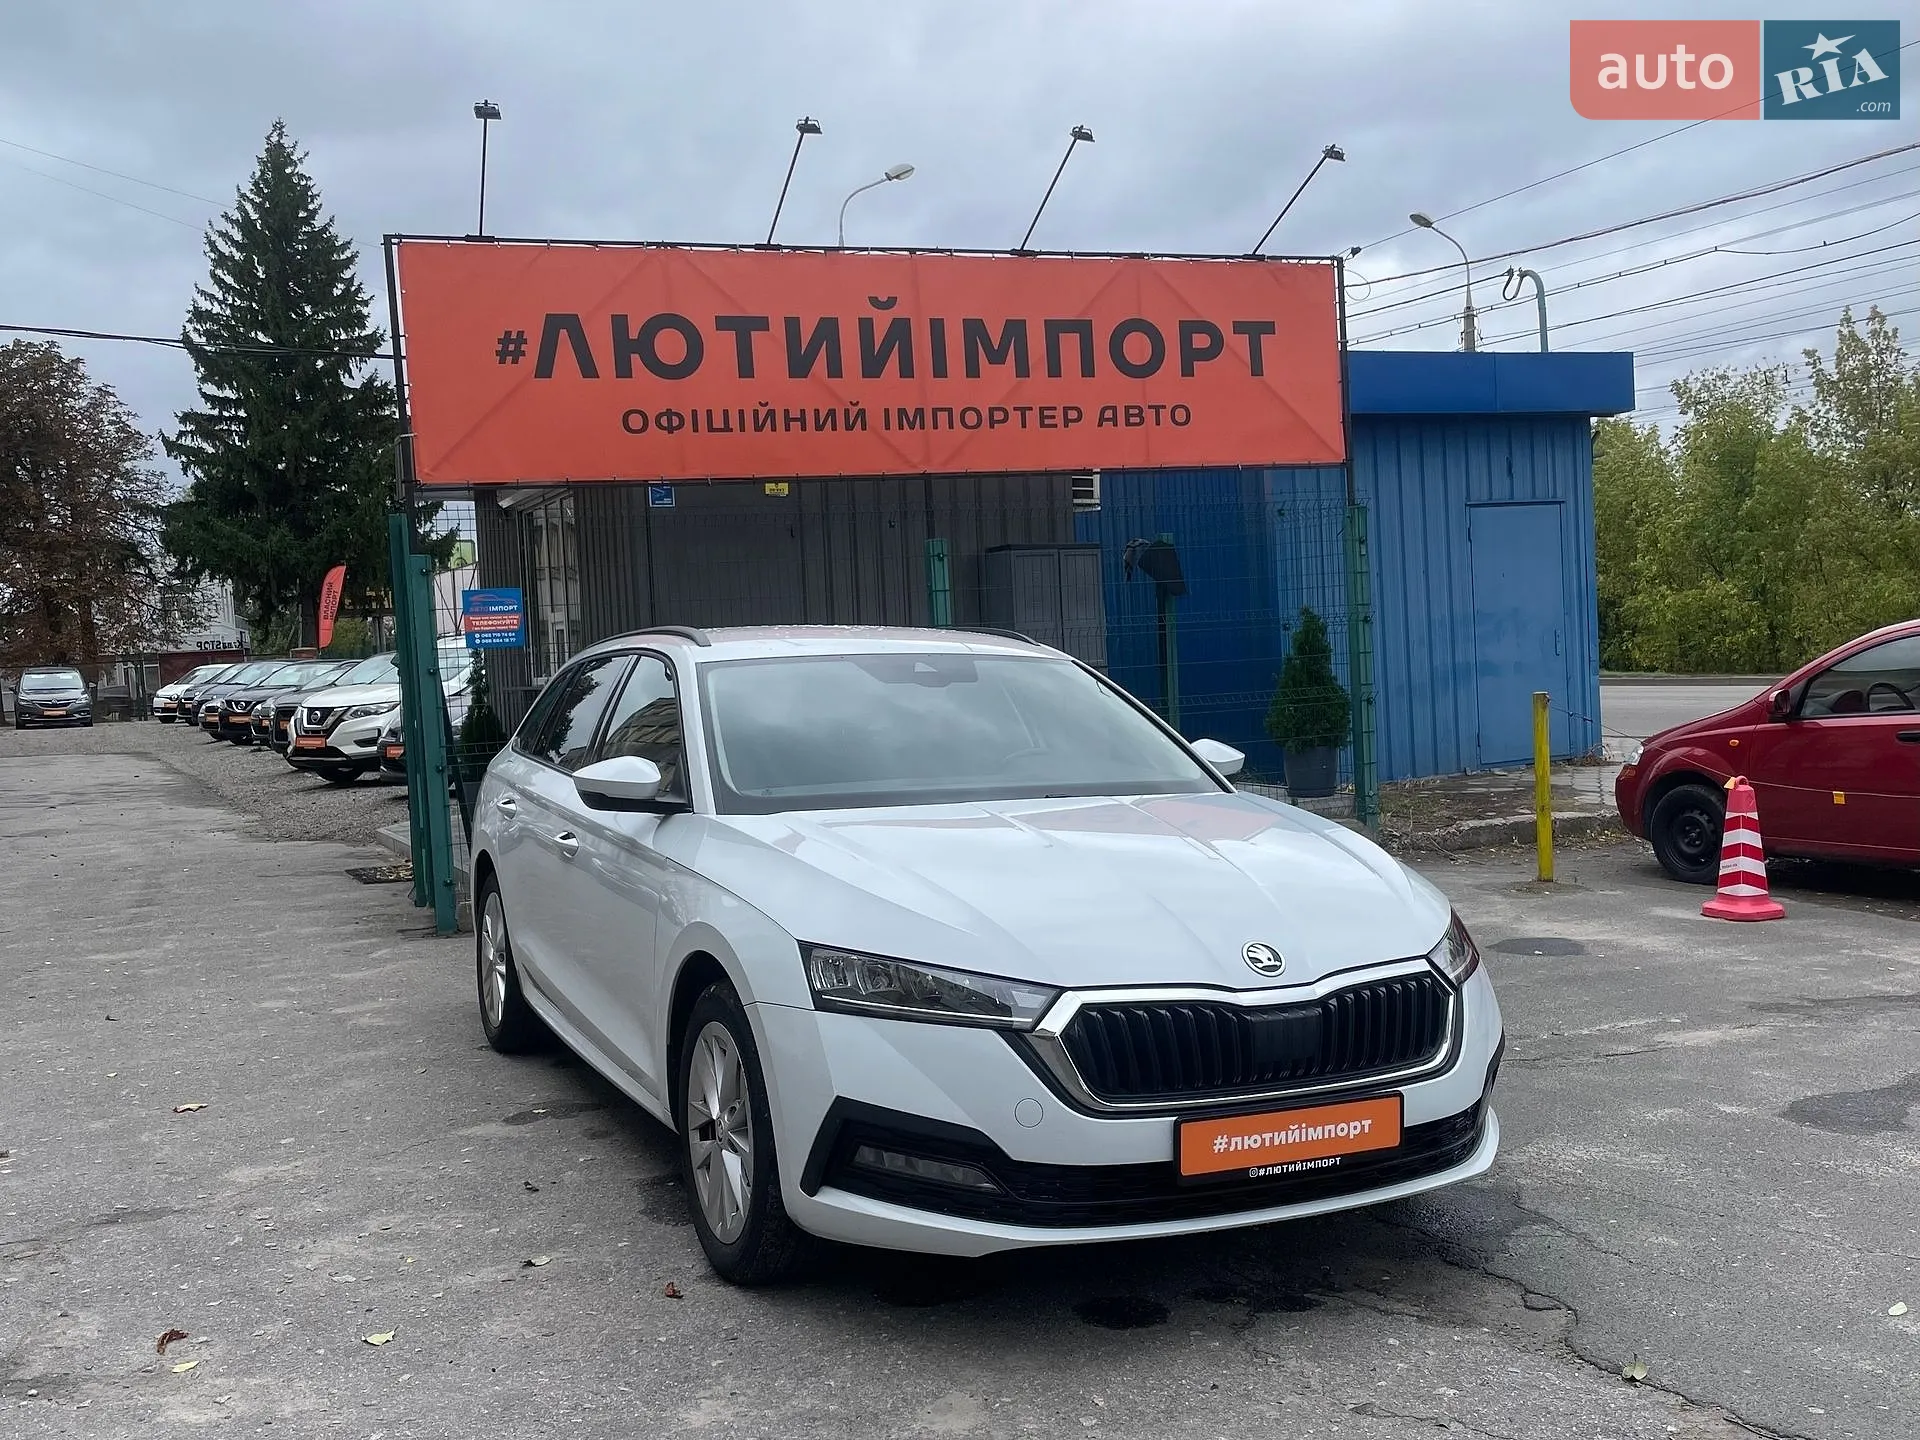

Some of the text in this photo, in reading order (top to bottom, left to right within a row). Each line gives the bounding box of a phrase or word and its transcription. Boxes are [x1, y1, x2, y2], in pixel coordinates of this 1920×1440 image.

[495, 296, 1276, 380] #ЛЮТИЙІМПОРТ
[621, 401, 1192, 434] ОФІЦІЙНИЙ ІМПОРТЕР АВТО
[1213, 1119, 1372, 1153] #лютийімпорт
